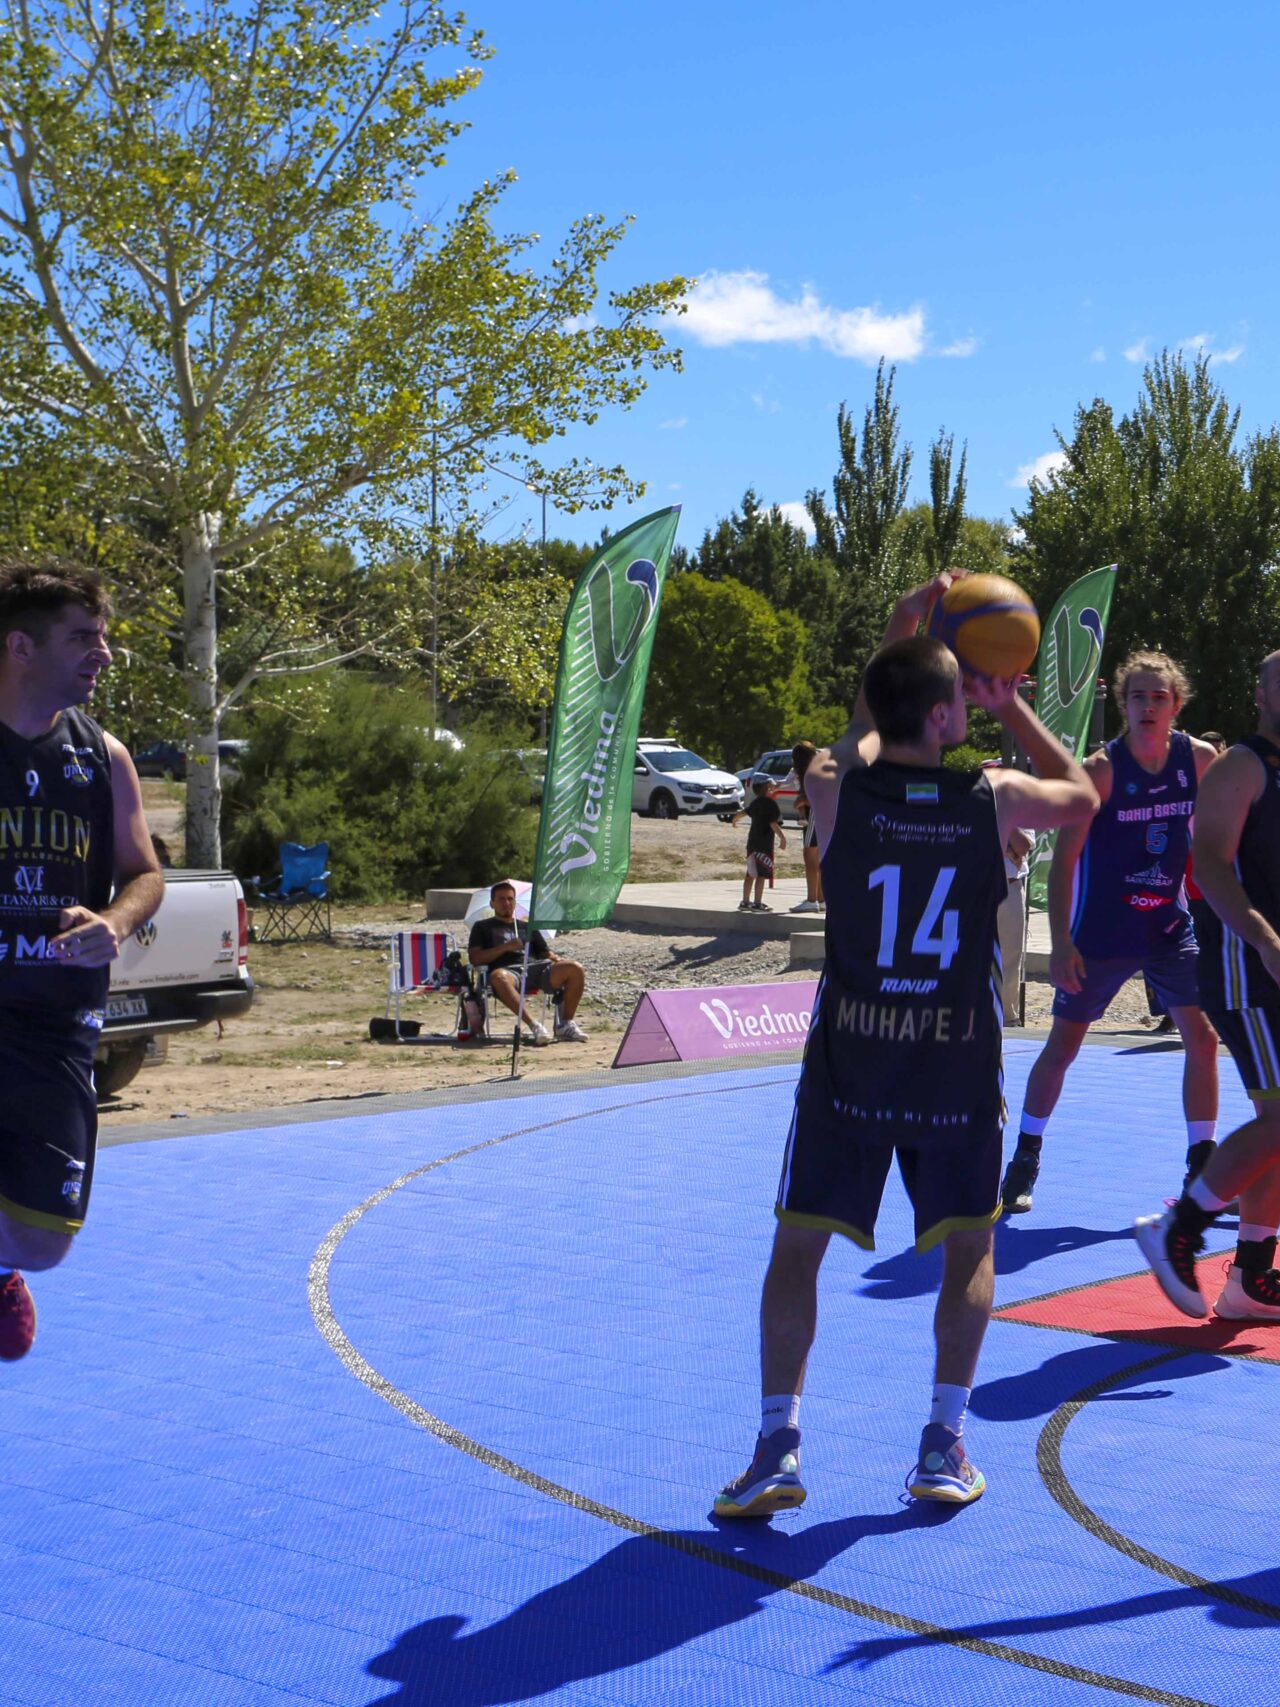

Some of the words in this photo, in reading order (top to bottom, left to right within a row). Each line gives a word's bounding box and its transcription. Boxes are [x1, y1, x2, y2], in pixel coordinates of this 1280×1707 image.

[25, 769, 40, 797] 9
[560, 710, 615, 875] Viedma
[0, 806, 91, 862] NION
[938, 823, 954, 834] del
[956, 824, 972, 836] Sur
[1146, 822, 1169, 855] 5
[868, 863, 960, 971] 14
[1130, 895, 1163, 907] DOW
[836, 997, 952, 1042] MUHAPE
